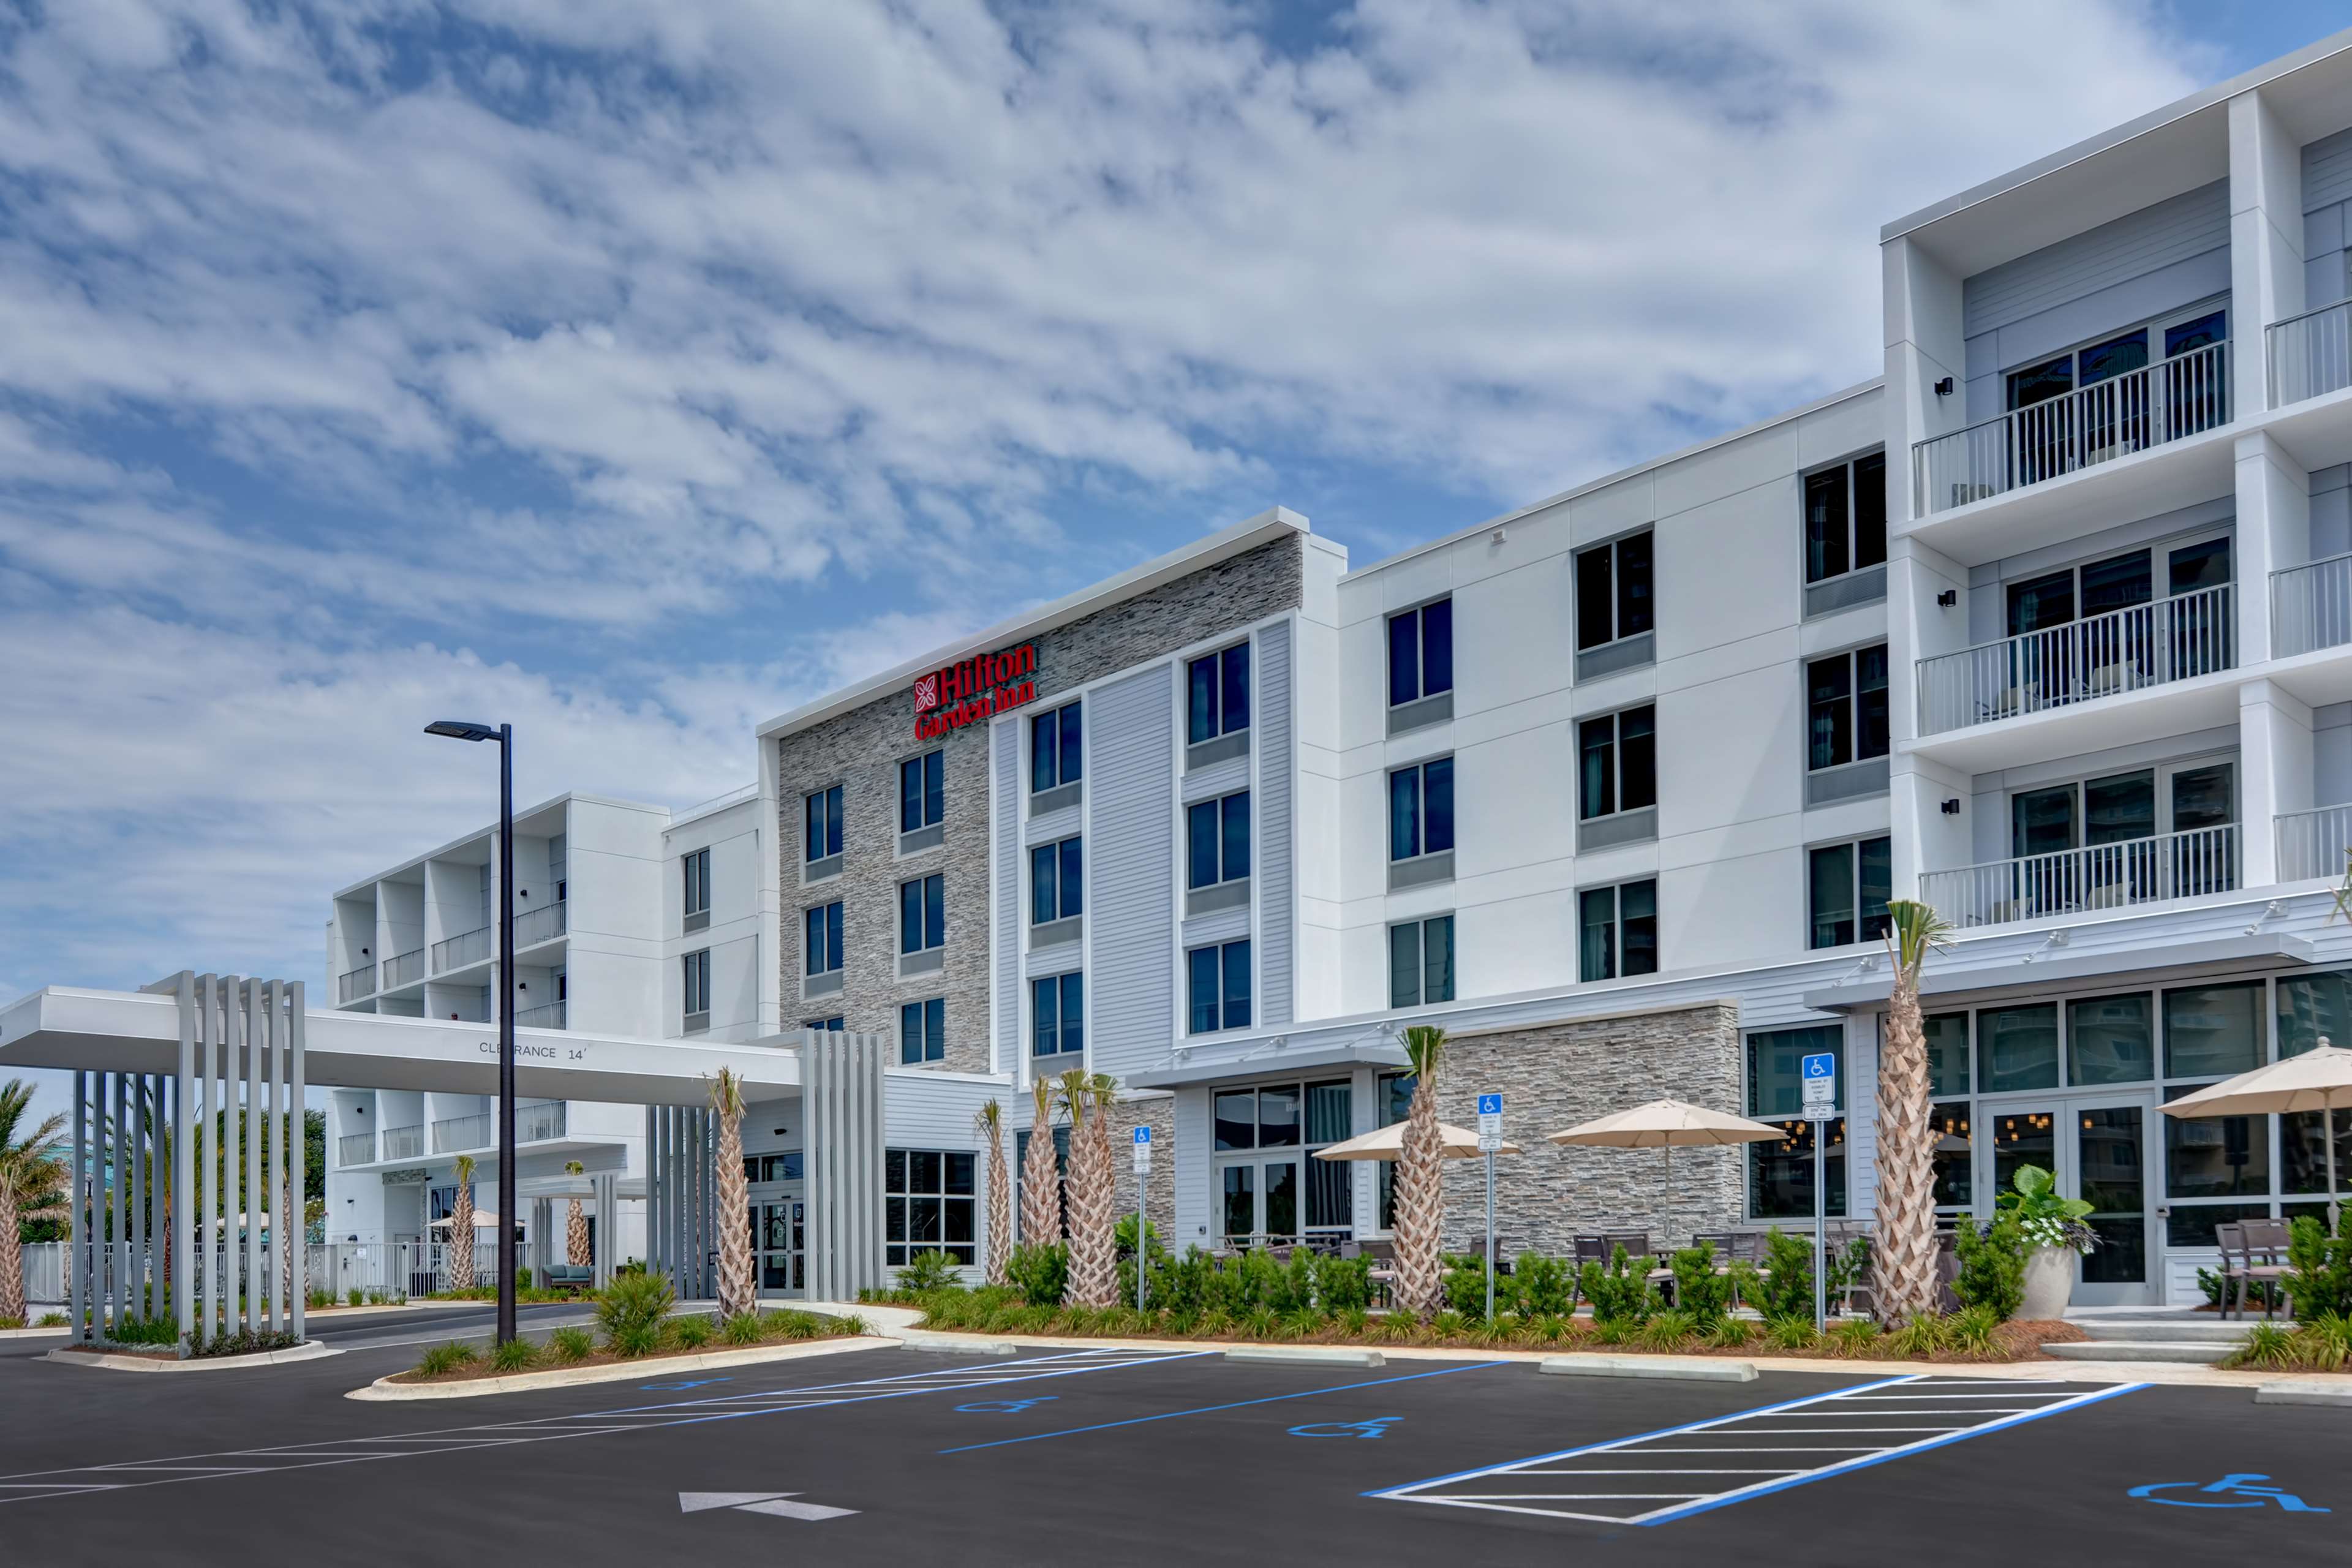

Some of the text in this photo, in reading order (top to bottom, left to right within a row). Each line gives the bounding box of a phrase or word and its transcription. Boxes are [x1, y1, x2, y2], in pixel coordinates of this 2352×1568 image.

[940, 643, 1035, 704] Hilton
[914, 681, 1035, 741] Garden Inn
[479, 1042, 587, 1060] CLERANCE 14'
